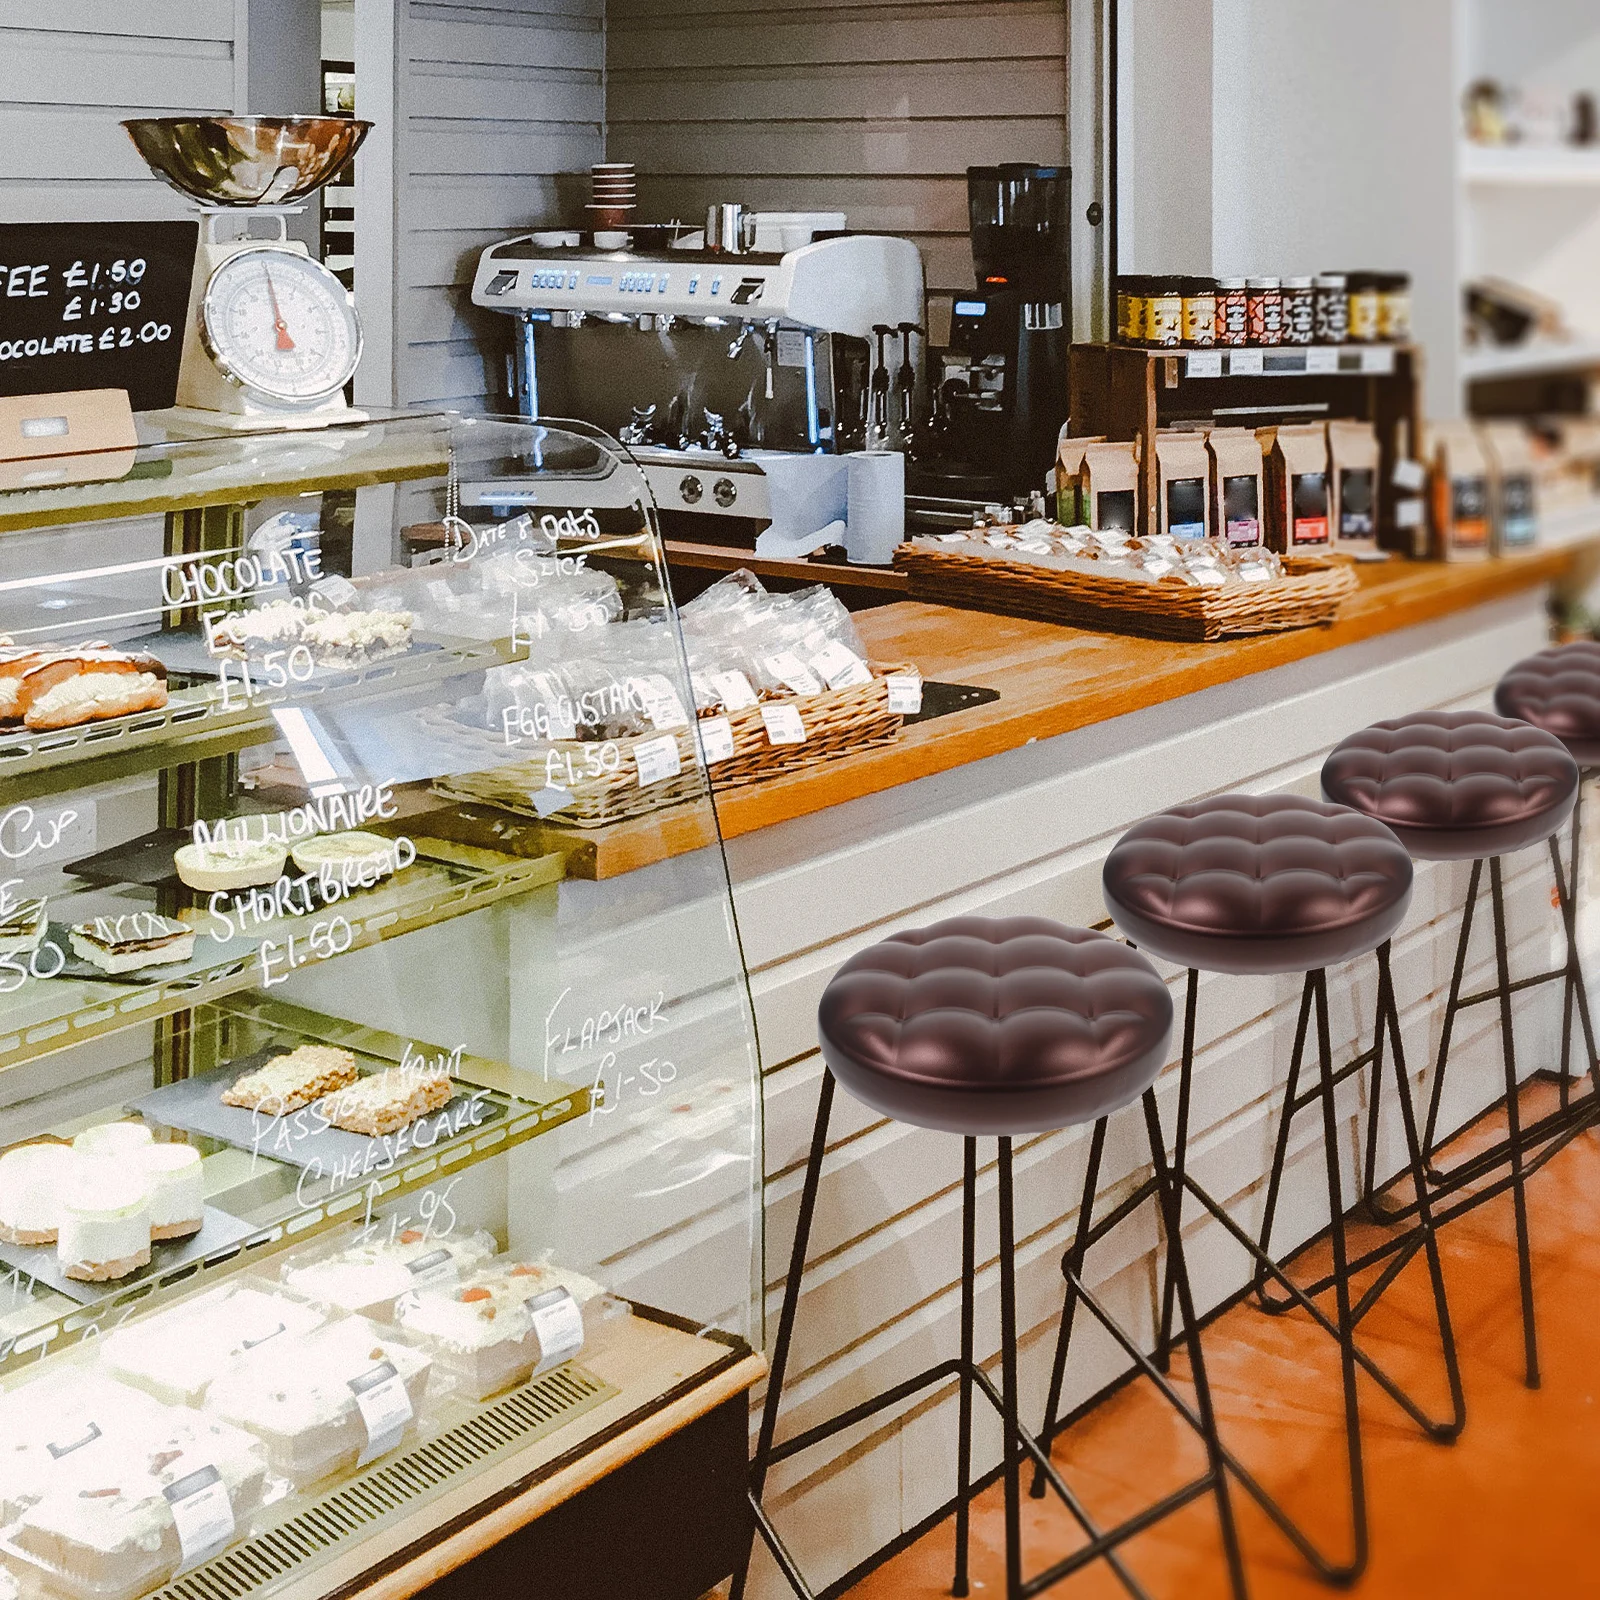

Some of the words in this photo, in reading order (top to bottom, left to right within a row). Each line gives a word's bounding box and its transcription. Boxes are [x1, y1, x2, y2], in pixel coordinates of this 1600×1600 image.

[63, 258, 146, 287] £1.50
[63, 291, 141, 321] £1.30
[99, 321, 172, 350] £2.00
[442, 516, 507, 562] DATE
[514, 548, 588, 587] SLICE
[161, 548, 324, 605] CHOCOLATE
[216, 645, 314, 711] £1.50
[502, 702, 554, 746] EGG
[558, 676, 655, 729] CUSTAR
[545, 741, 620, 792] £1.50
[193, 777, 399, 862] MILLIONAIRE
[208, 836, 417, 943] SHORTBREAD
[260, 915, 353, 989] £1.50
[543, 987, 669, 1083] FLAPJACK
[296, 1089, 491, 1209] CHEESECAKE
